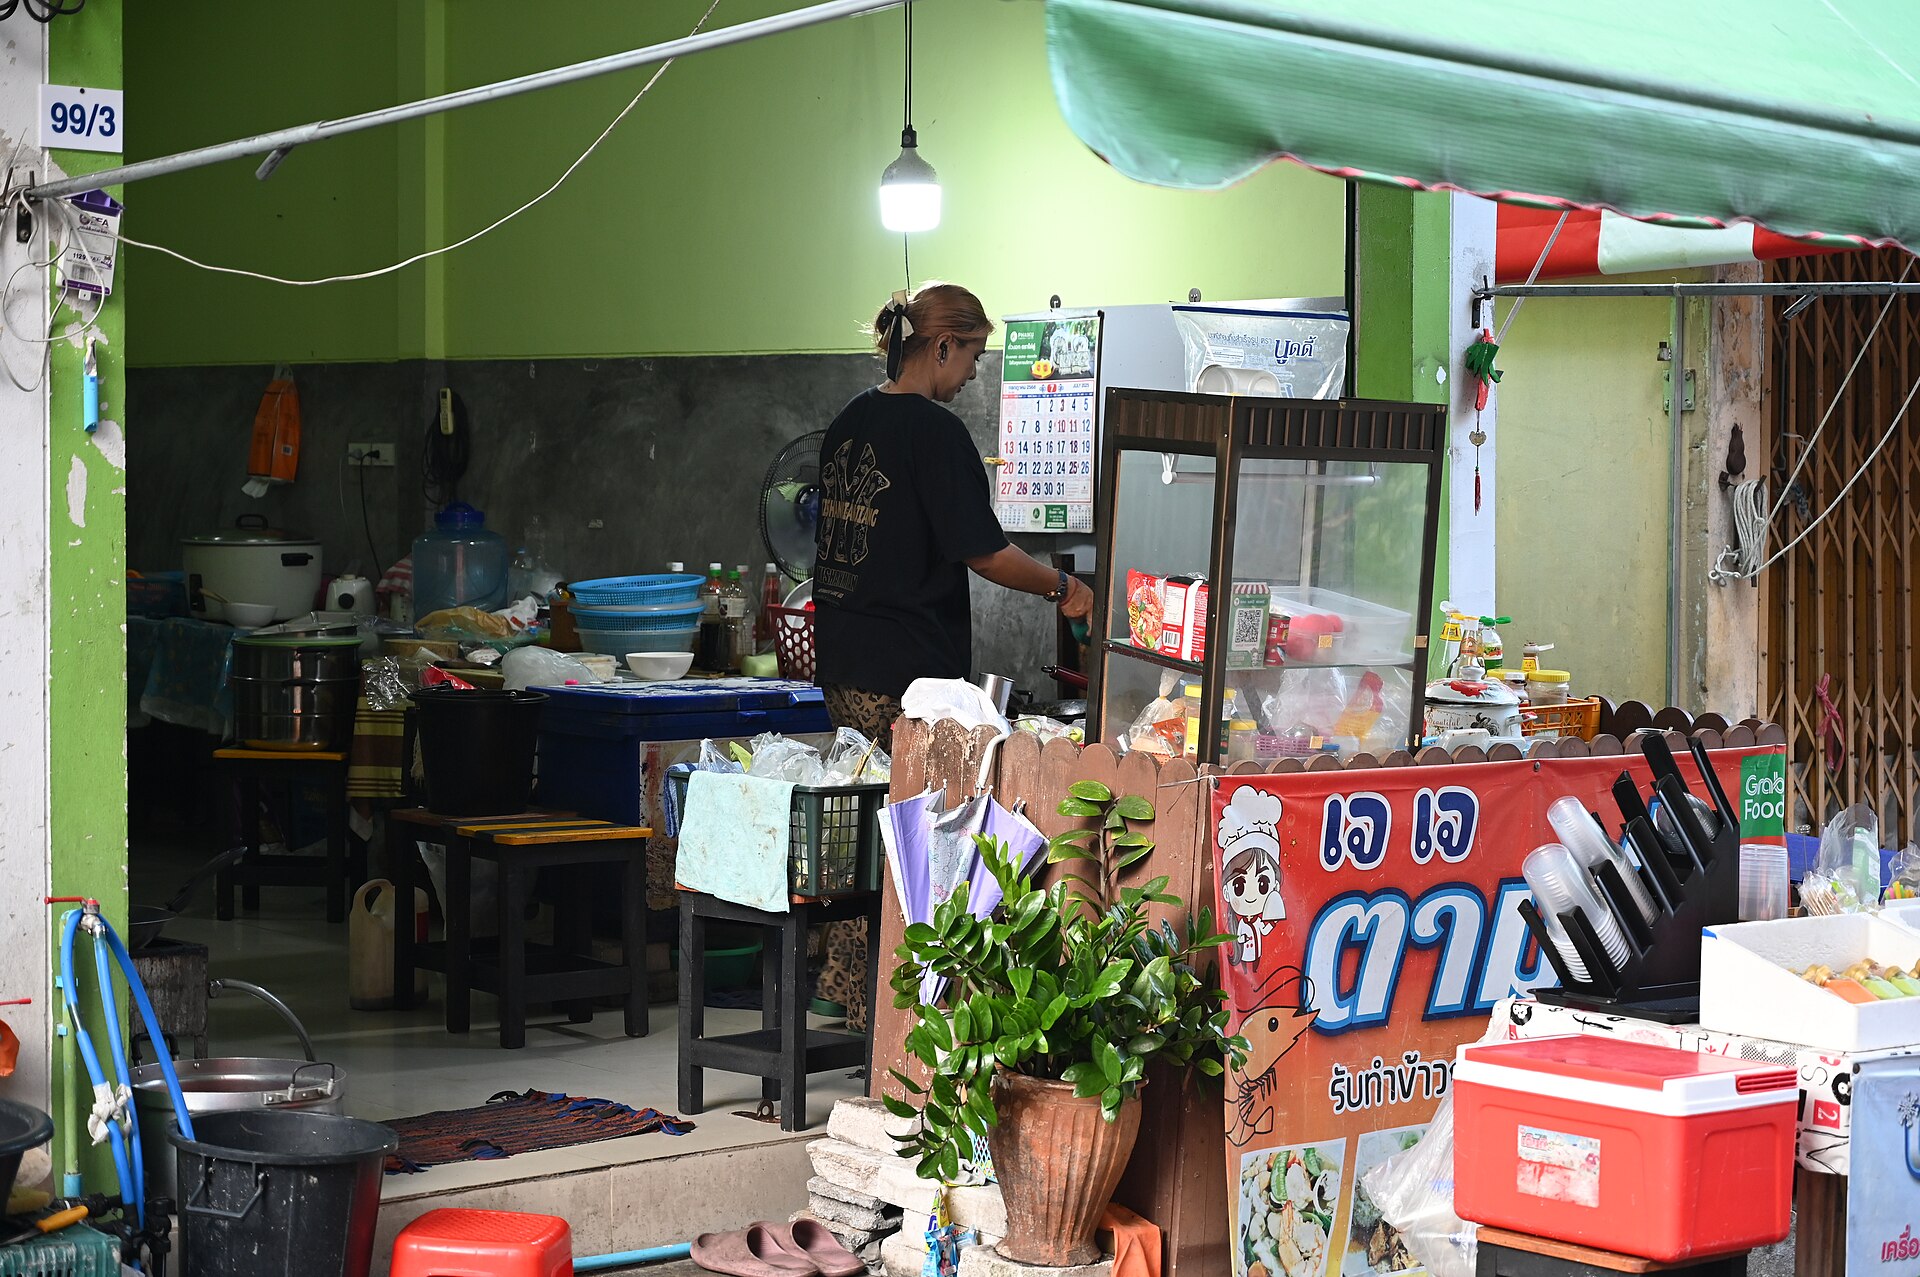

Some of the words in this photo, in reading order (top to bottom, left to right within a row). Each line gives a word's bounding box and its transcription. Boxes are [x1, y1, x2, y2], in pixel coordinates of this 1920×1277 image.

[50, 101, 116, 137] 99/3
[1274, 335, 1317, 365] นูดดี้
[1049, 399, 1054, 412] 2
[1060, 399, 1065, 411] 3
[1071, 398, 1076, 411] 4
[1083, 397, 1089, 411] 5
[1007, 420, 1013, 433] 6
[1021, 420, 1027, 433] 7
[1035, 420, 1040, 433] 8
[1048, 420, 1053, 433] 9
[1057, 420, 1066, 433] 10
[1070, 420, 1078, 433] 11
[1082, 419, 1090, 432] 12
[1004, 440, 1014, 454] 13
[1018, 441, 1028, 454] 14
[1033, 441, 1042, 454] 15
[1046, 440, 1053, 454] 16
[1057, 440, 1066, 454] 17
[1069, 440, 1078, 454] 18
[1082, 440, 1090, 453] 19
[1003, 461, 1014, 475] 20
[1017, 461, 1028, 475] 21
[1032, 461, 1041, 475] 22
[1044, 461, 1053, 475] 23
[1056, 461, 1066, 475] 24
[1068, 461, 1078, 474] 25
[1080, 461, 1090, 474] 26
[1001, 482, 1012, 495] 27
[1016, 481, 1028, 495] 28
[1031, 482, 1041, 495] 29
[1044, 482, 1053, 495] 30
[1056, 482, 1065, 495] 31
[1745, 771, 1785, 796] Grab
[1321, 794, 1390, 870] เจ
[1412, 788, 1478, 862] เจ
[1305, 878, 1560, 1035] ตาม
